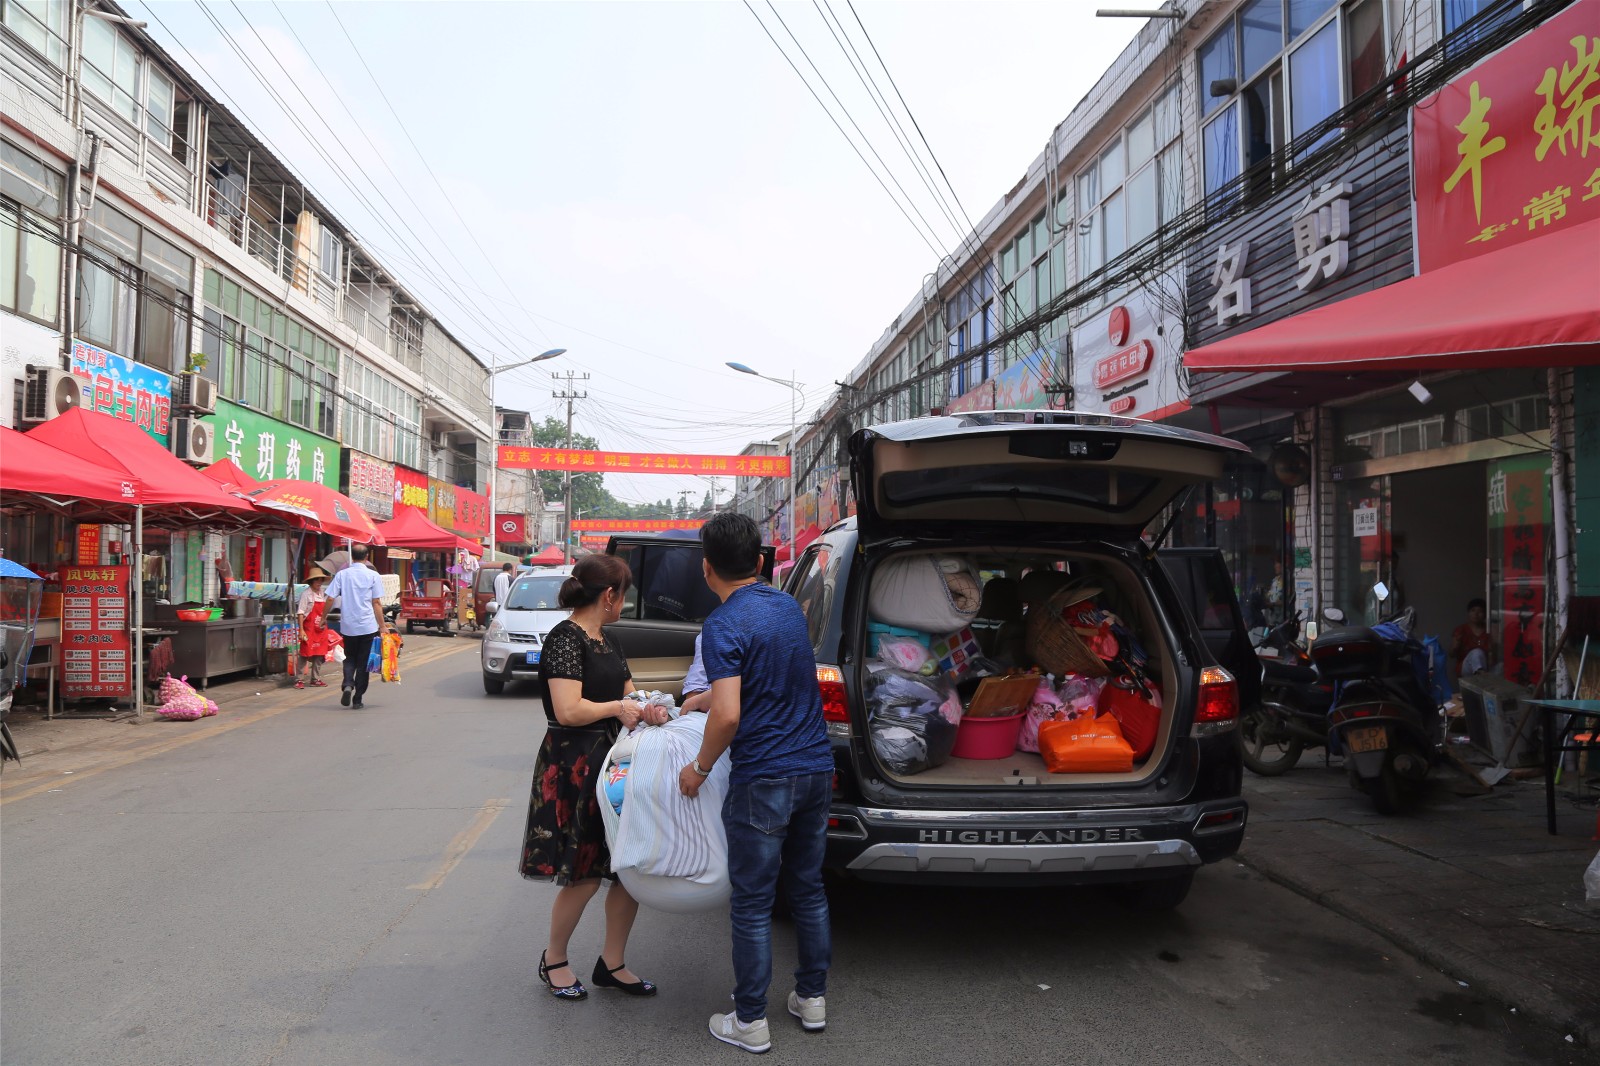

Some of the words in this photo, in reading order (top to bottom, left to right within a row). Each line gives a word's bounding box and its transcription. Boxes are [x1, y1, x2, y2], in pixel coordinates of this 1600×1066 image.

[1209, 183, 1354, 326] 名剪
[75, 344, 107, 368] 老刘家
[74, 366, 170, 435] 色羊肉馆
[225, 419, 325, 485] 宝玥药房
[504, 450, 530, 462] 立志
[540, 452, 595, 465] 才有梦想
[604, 455, 631, 467] 明理
[640, 456, 692, 469] 才会做人
[702, 458, 727, 470] 拼搏
[736, 459, 787, 471] 才更精彩
[65, 585, 119, 594] 脆皮鸡饭
[73, 634, 113, 643] 烤肉饭
[919, 828, 1145, 843] HIGHLANDER
